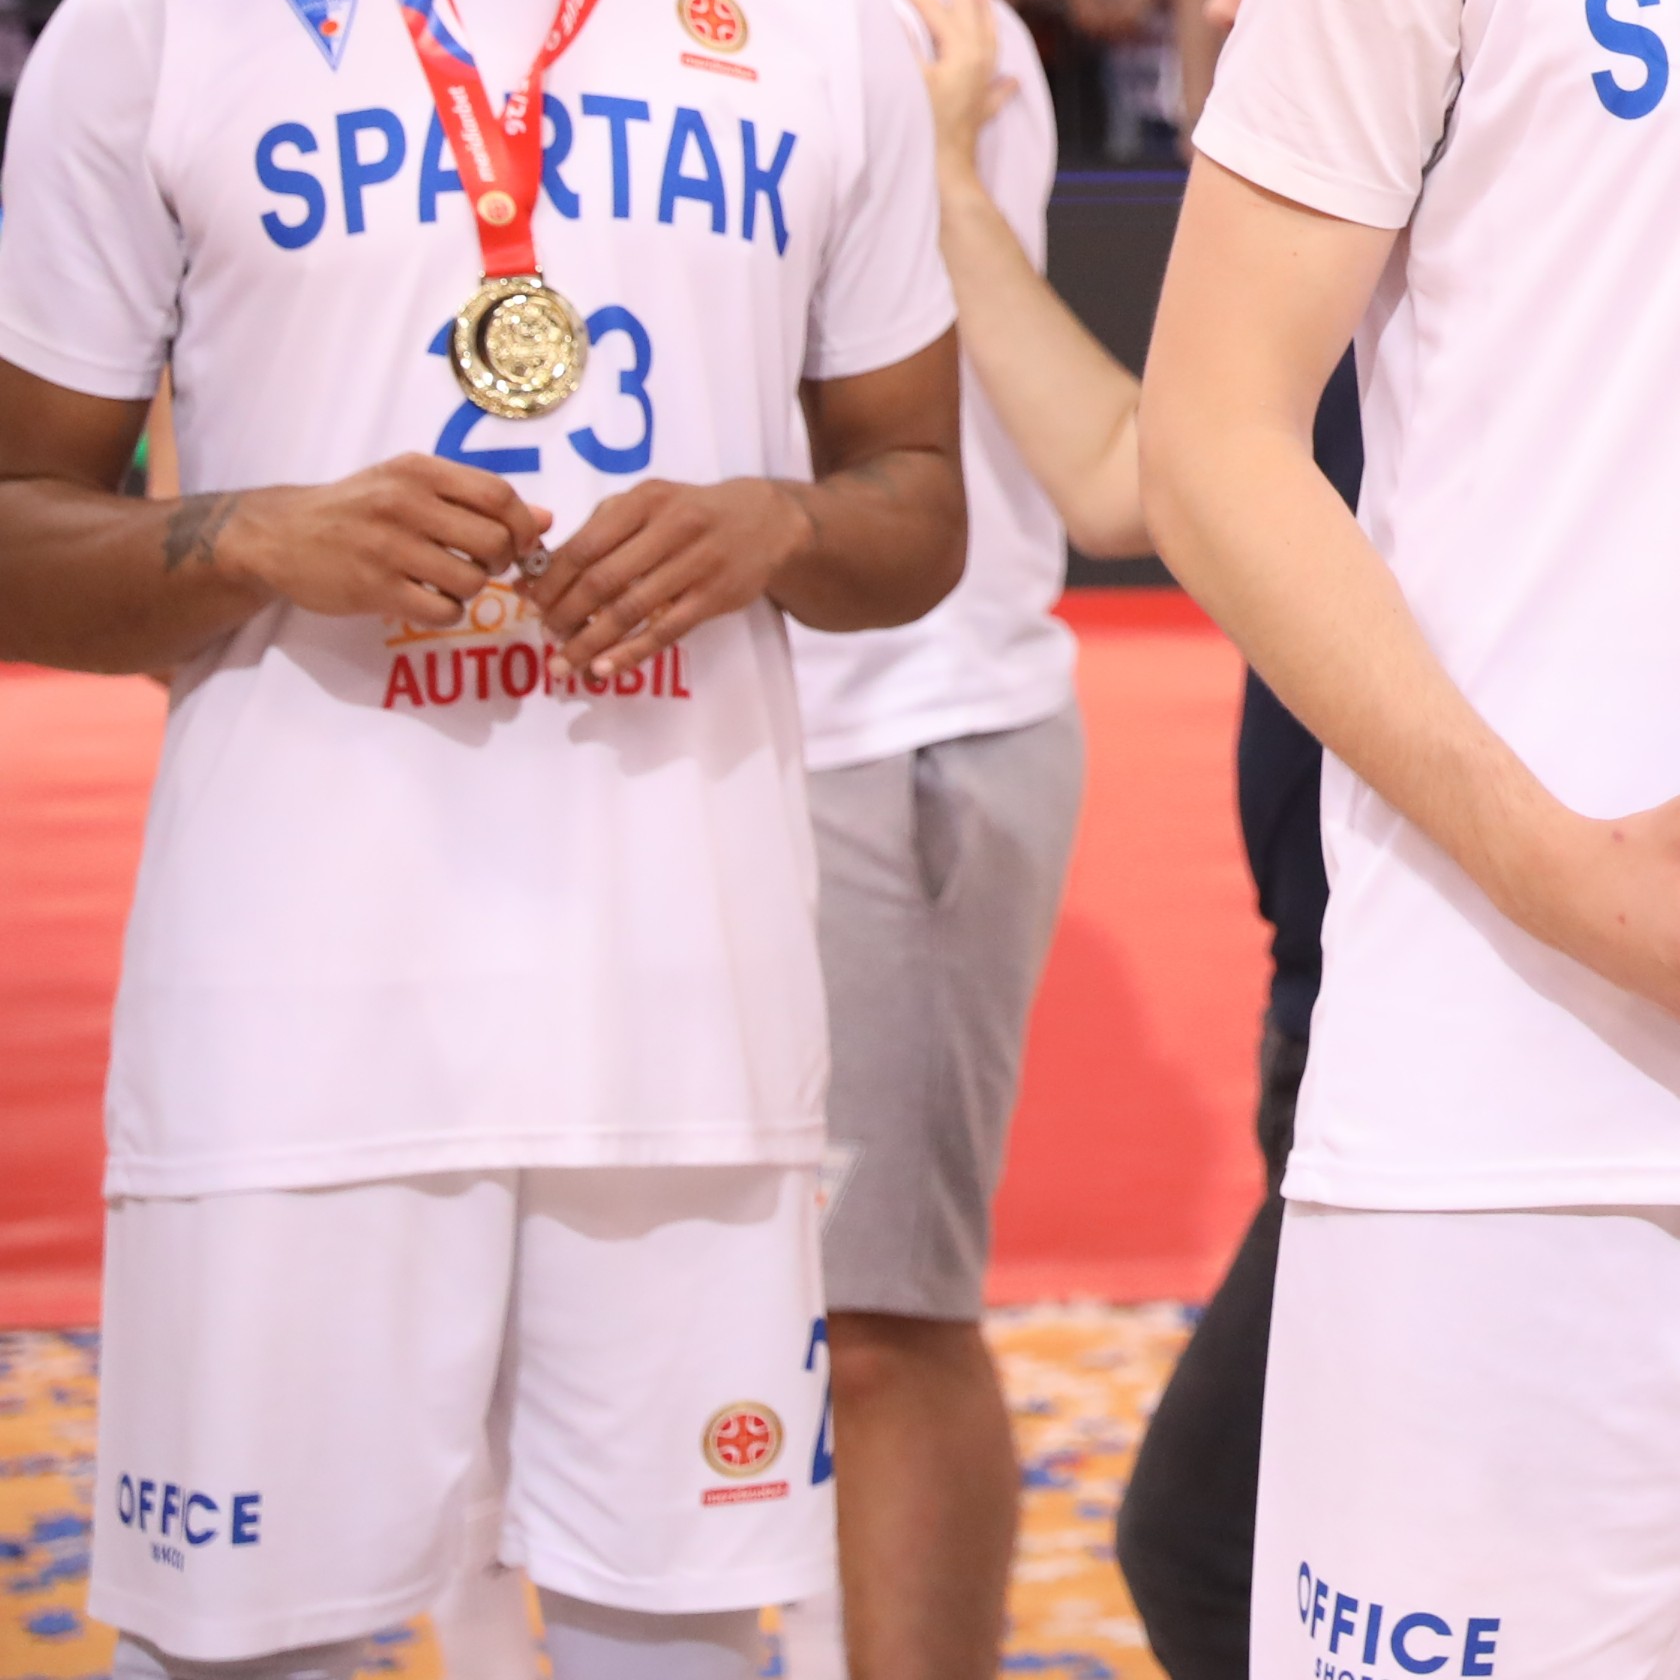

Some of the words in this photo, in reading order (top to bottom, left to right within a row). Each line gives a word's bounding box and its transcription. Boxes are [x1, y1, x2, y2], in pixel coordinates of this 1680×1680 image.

[426, 305, 653, 475] 23
[118, 1473, 262, 1545] OFFICE
[1297, 1560, 1502, 1678] OFFICE
